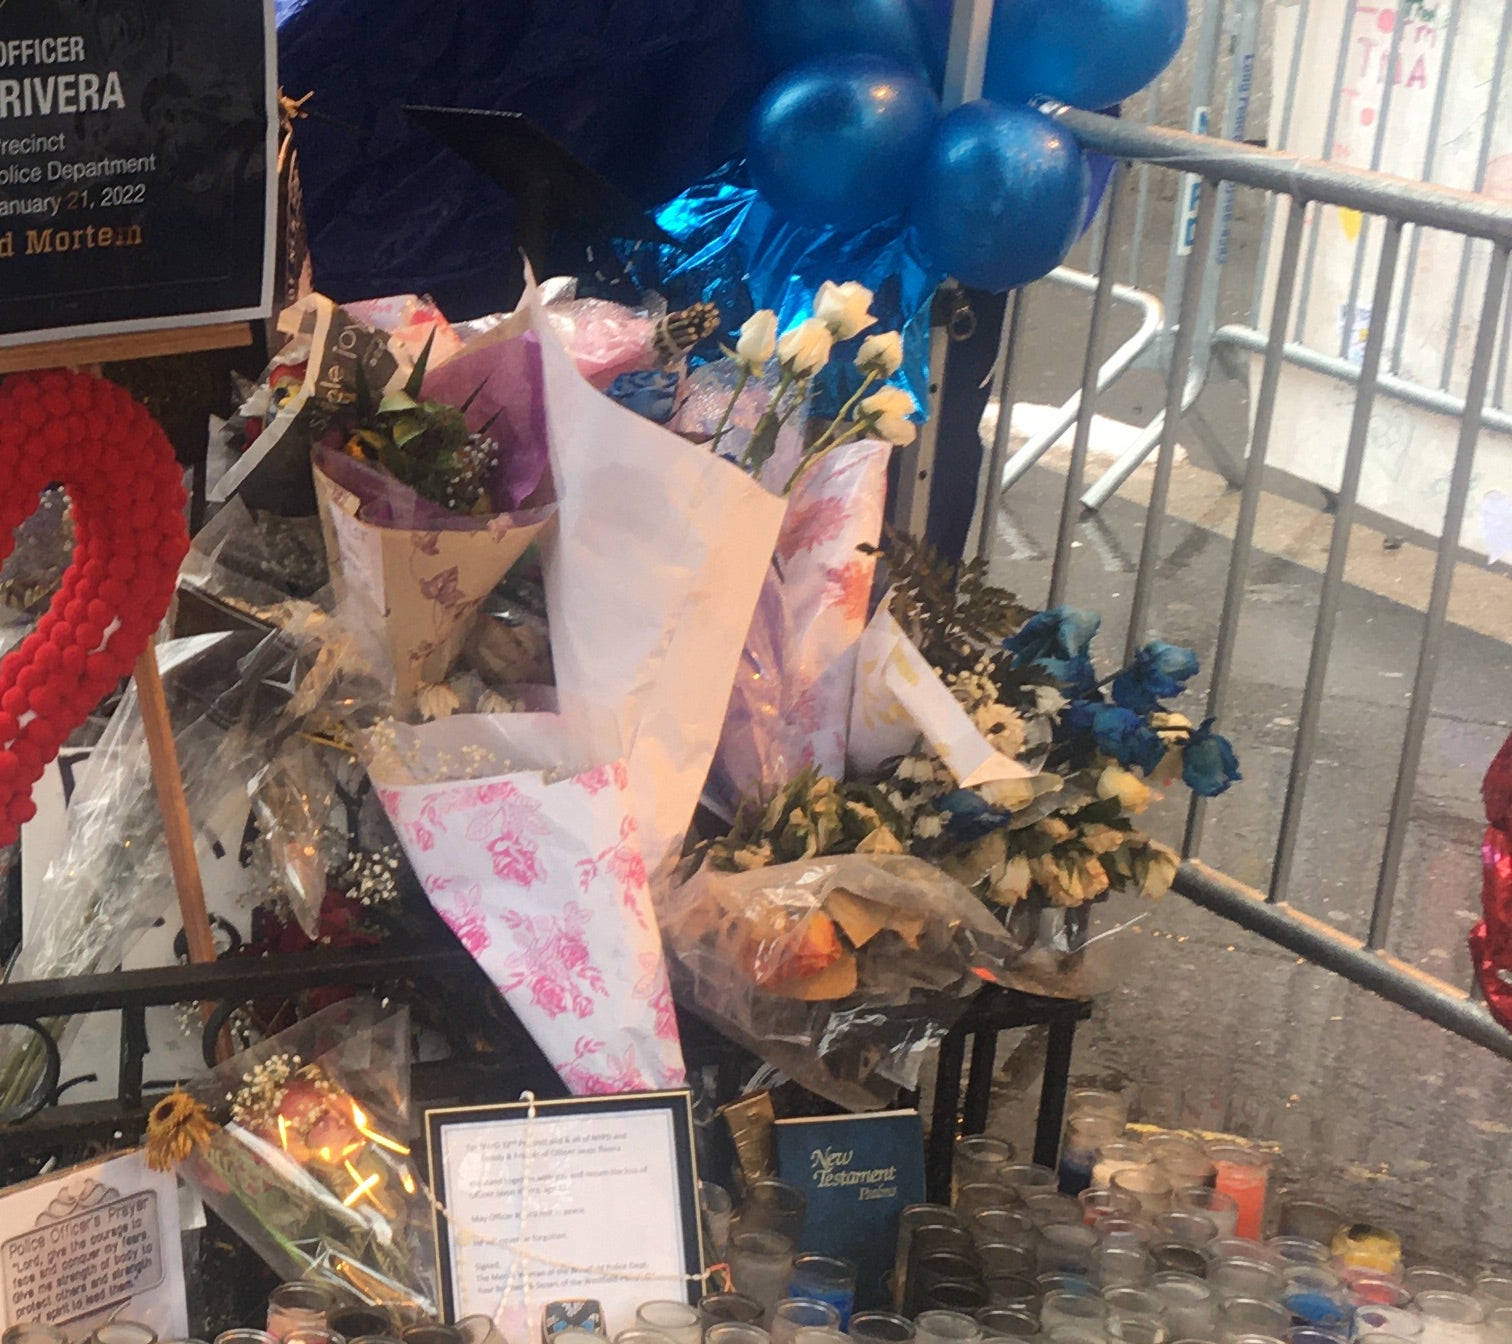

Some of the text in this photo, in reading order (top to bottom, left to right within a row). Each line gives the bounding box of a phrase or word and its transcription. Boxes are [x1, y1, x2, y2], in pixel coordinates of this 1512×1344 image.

[47, 153, 157, 184] Department
[67, 190, 94, 211] 21,
[101, 184, 146, 207] 2022
[26, 224, 143, 256] Mortem
[810, 1145, 854, 1170] New
[813, 1165, 896, 1188] Testament
[858, 1183, 897, 1200] Psalms
[9, 1198, 149, 1258] Police Officer's Prayer
[47, 1245, 67, 1264] give
[70, 1238, 86, 1250] the
[90, 1225, 129, 1244] courage
[131, 1218, 142, 1229] to
[12, 1232, 149, 1289] face and conquer my fears.
[12, 1243, 153, 1304] Give me strength of body to
[15, 1258, 152, 1320] protect others and strength
[45, 1304, 70, 1322] spirit
[72, 1298, 83, 1310] to
[85, 1289, 106, 1305] lead
